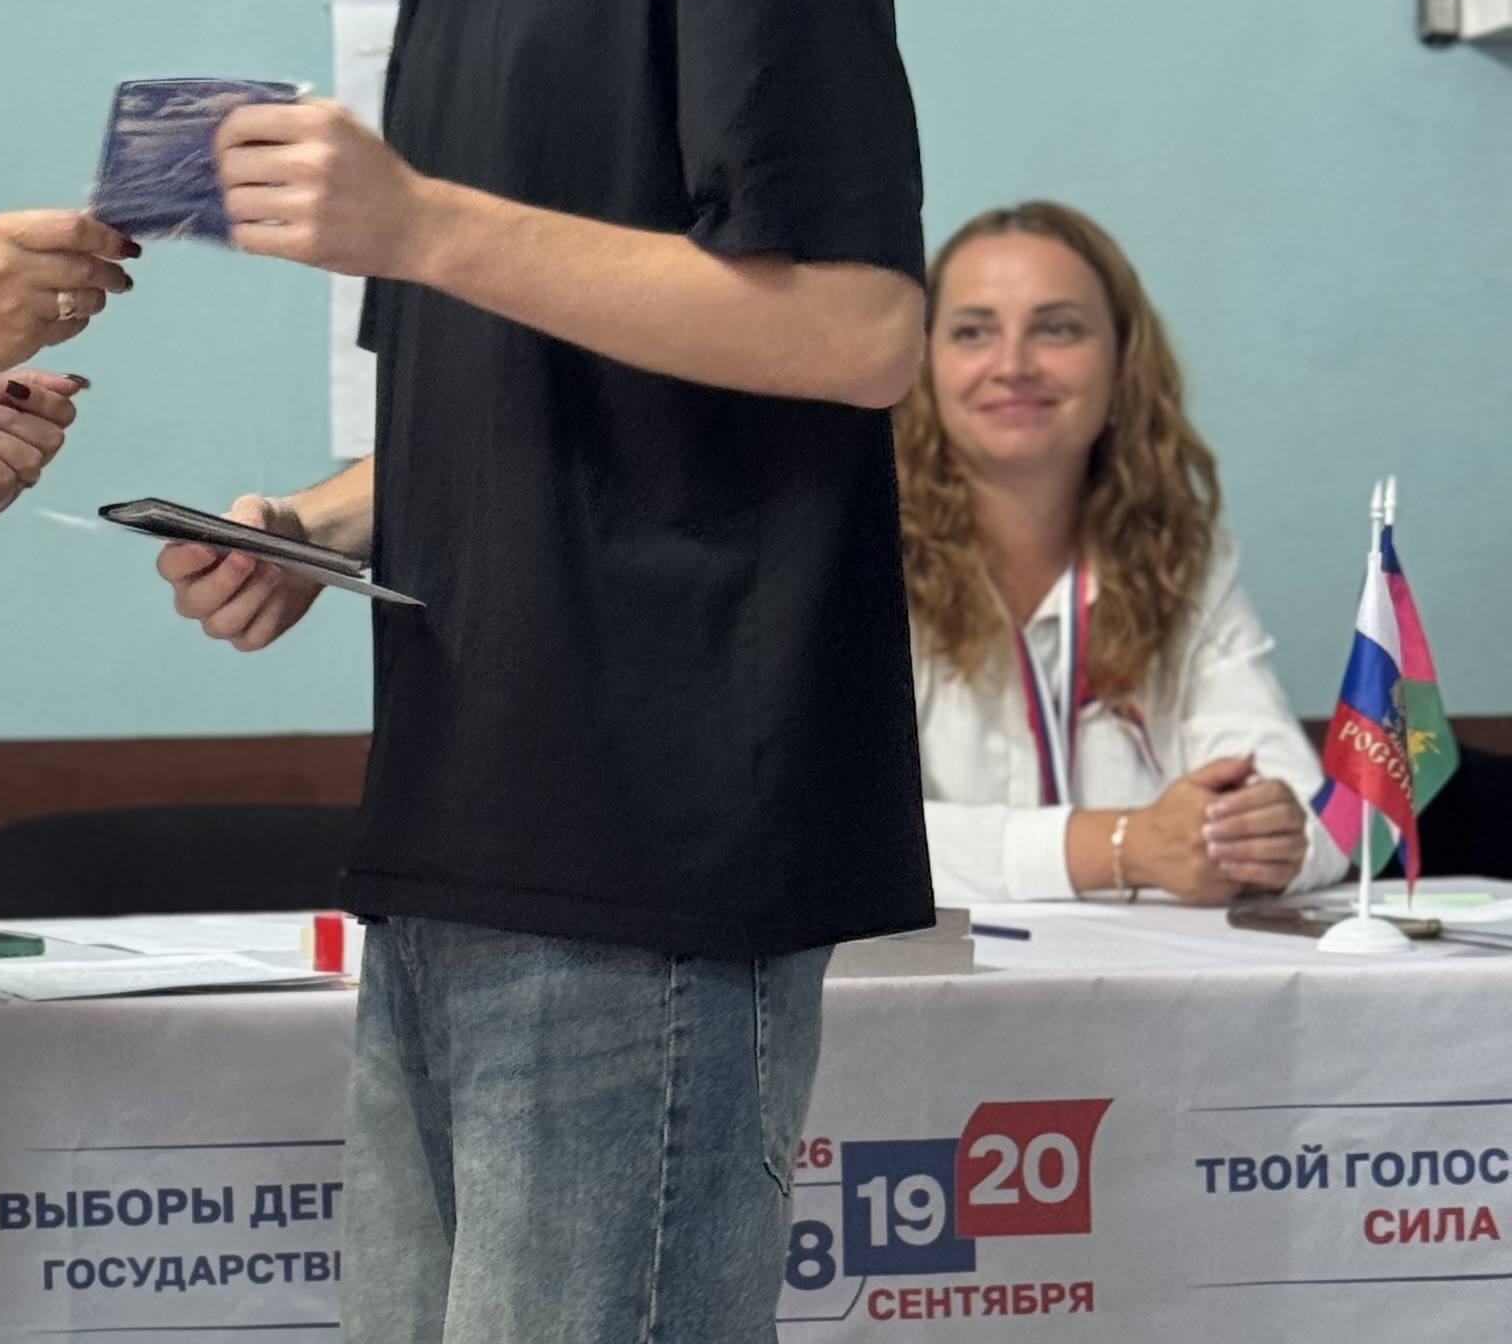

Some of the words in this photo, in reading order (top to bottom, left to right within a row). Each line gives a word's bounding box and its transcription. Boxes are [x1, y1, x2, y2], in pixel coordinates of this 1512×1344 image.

[1338, 720, 1414, 808] РОССИ
[1194, 1143, 1330, 1194] ТВОЙ
[1345, 1147, 1510, 1189] ГОЛОС
[248, 1181, 345, 1230] ДЕП
[785, 1219, 837, 1292] 8
[856, 1173, 947, 1247] 19
[968, 1132, 1080, 1206] 20
[1363, 1205, 1501, 1245] СИЛА
[42, 1250, 342, 1293] ГОСУДАРСТВ
[867, 1281, 1095, 1321] СЕНТЯБРЯ
